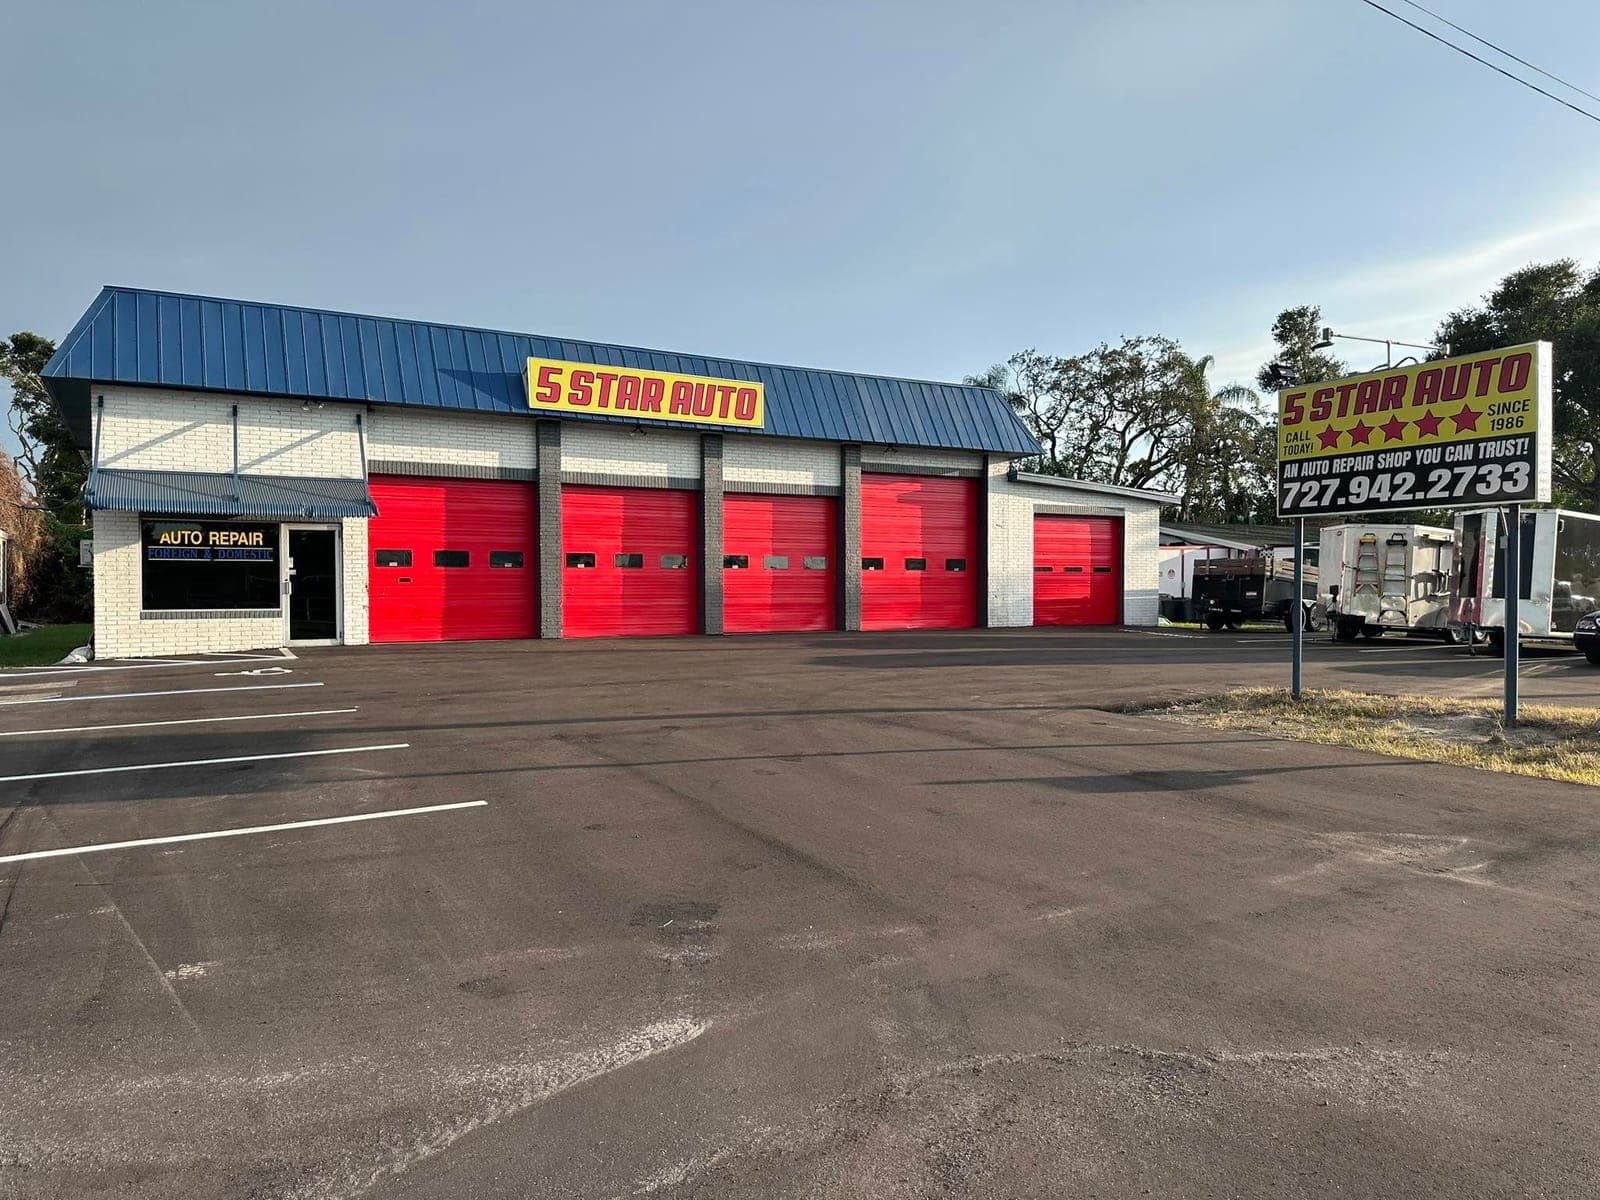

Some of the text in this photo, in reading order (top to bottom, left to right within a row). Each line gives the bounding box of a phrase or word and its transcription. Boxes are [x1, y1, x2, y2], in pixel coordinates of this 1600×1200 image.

[536, 366, 757, 421] 5 STAR AUTO
[1283, 352, 1532, 426] 5 STAR AUTO
[1487, 399, 1531, 416] SINCE
[1490, 416, 1525, 431] 1986
[1285, 431, 1311, 444] CALL
[1283, 444, 1314, 456] TODAY!
[1283, 437, 1530, 479] AN AUTO REPAIR SHOP YOU CAN TRUST!
[1282, 461, 1531, 509] 727.942.2733
[160, 530, 264, 546] AUTO REPAIR
[147, 547, 273, 560] FOREIGN & DOMESTIC
